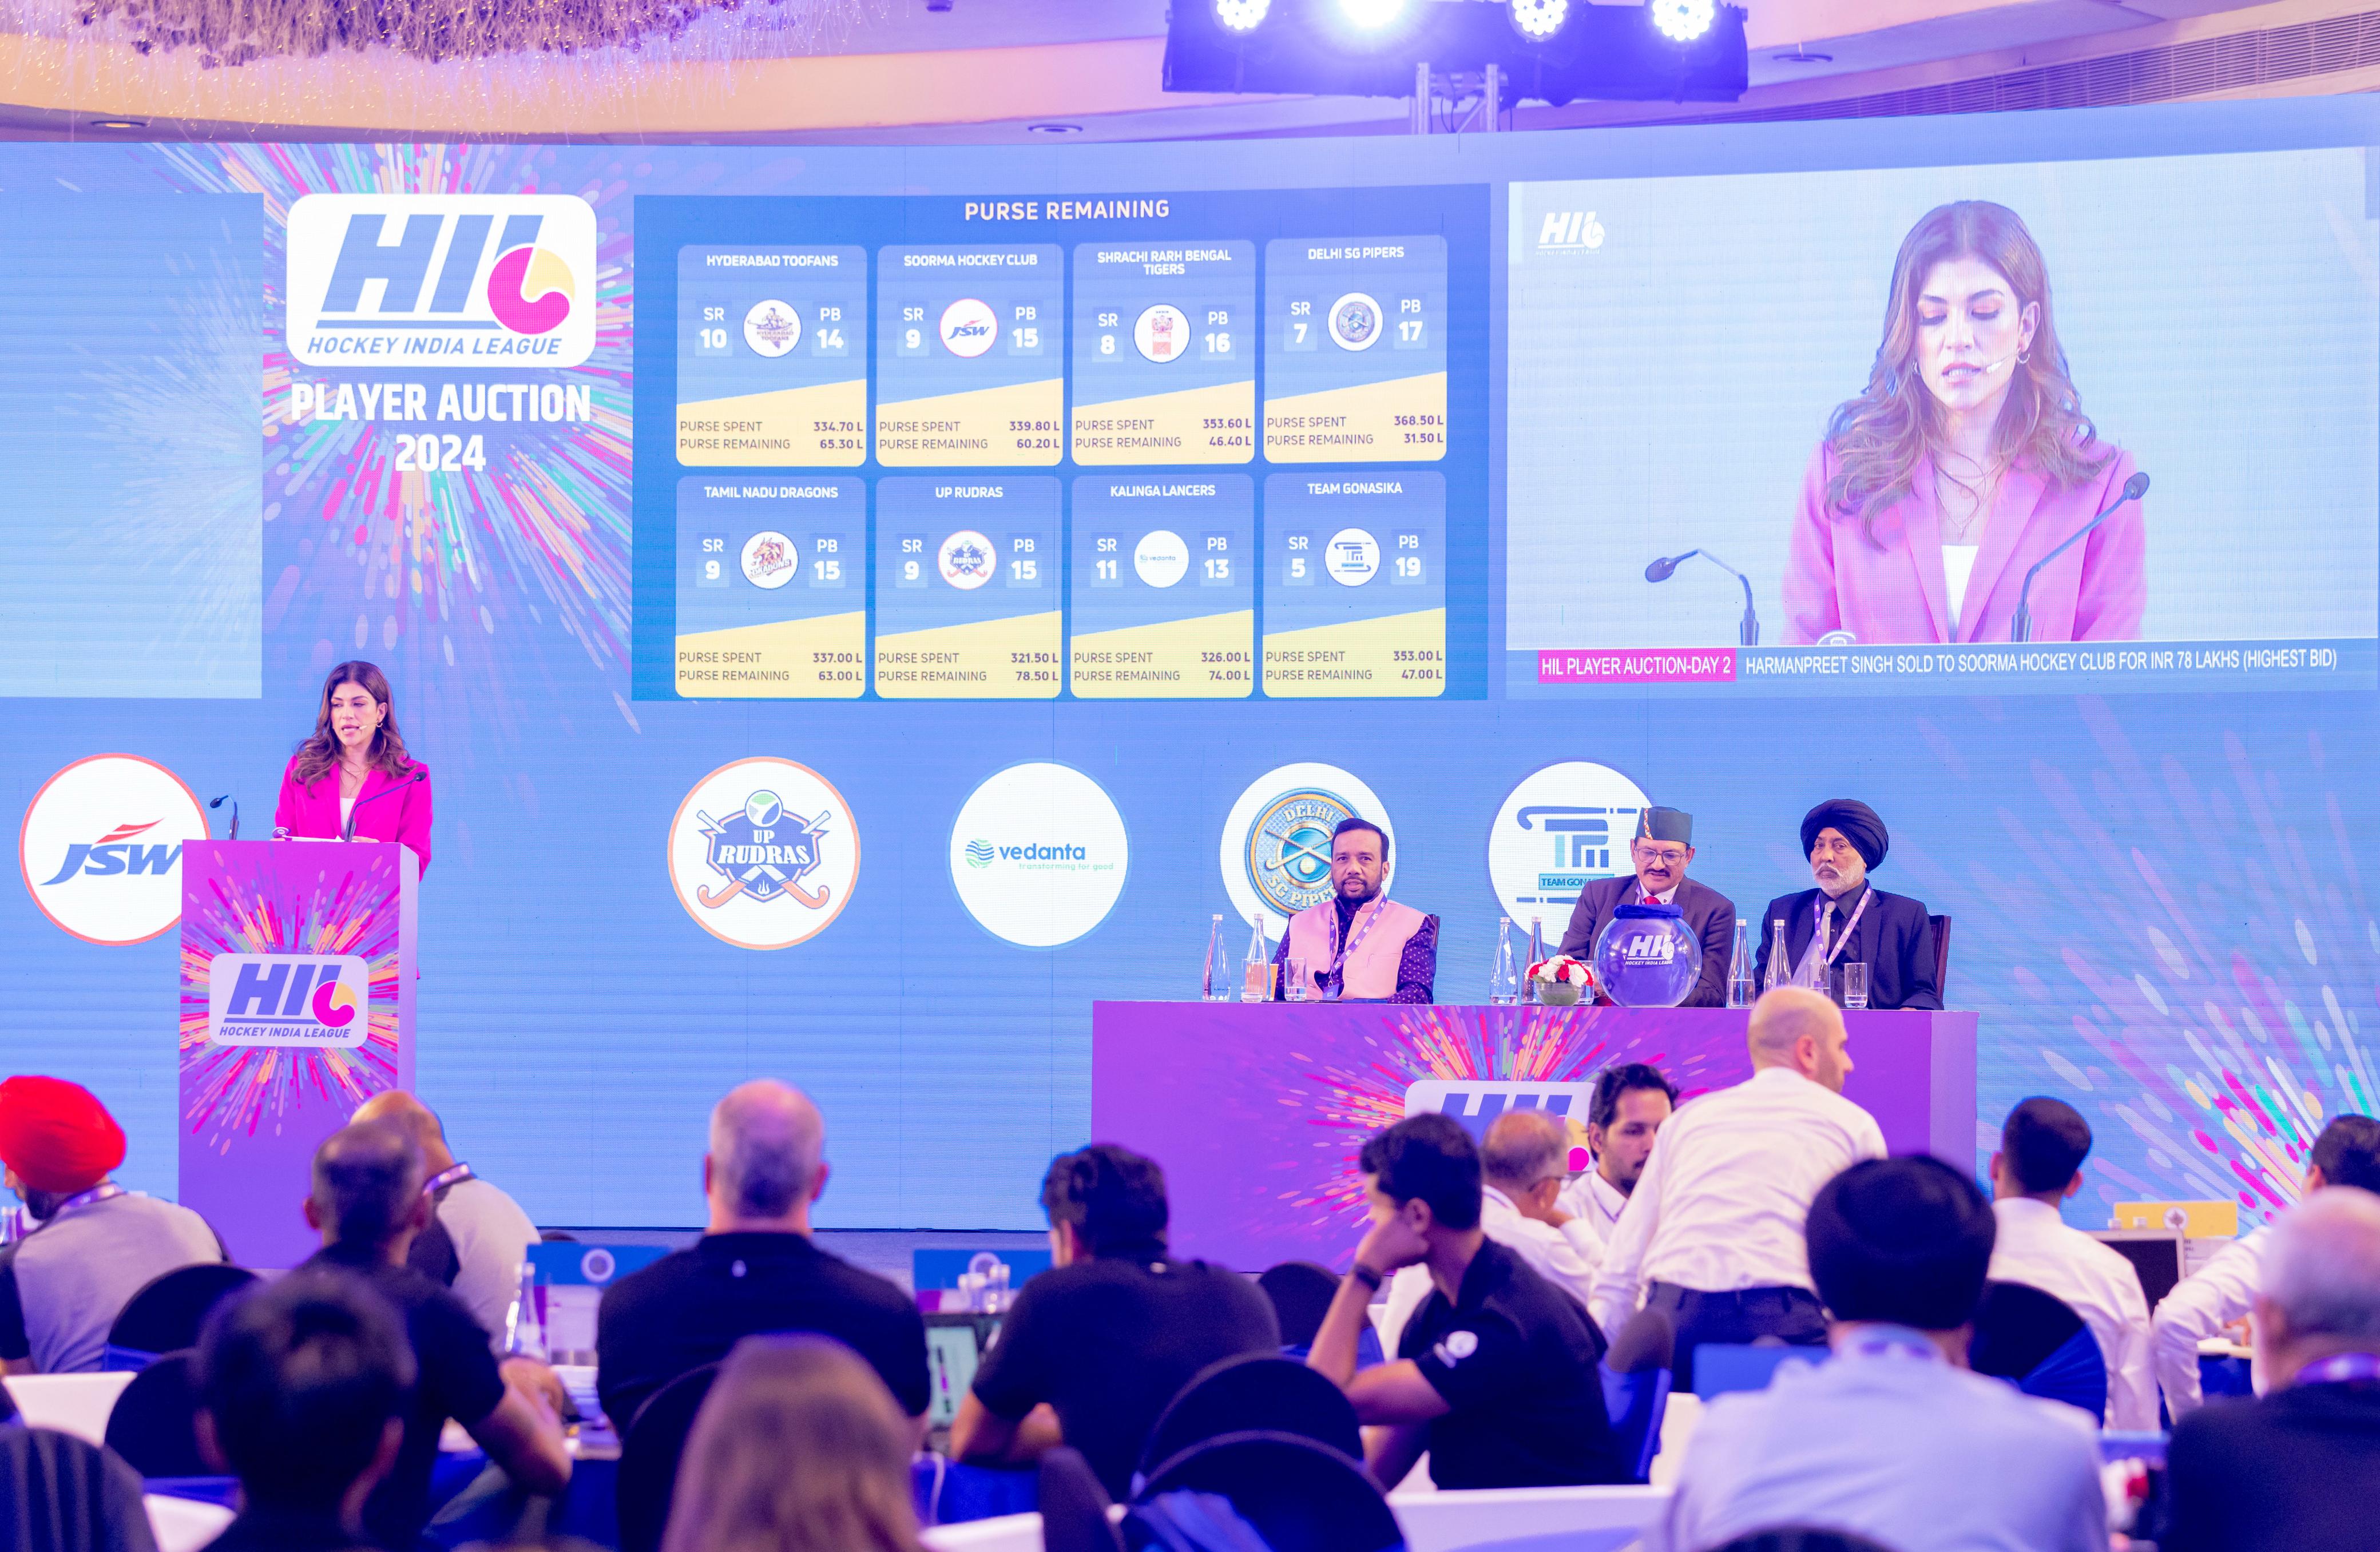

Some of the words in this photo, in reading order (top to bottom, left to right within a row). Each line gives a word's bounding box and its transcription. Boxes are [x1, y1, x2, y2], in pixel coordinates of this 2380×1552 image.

[965, 202, 1038, 220] PURSE
[1047, 200, 1169, 220] REMAINING
[1098, 251, 1148, 263] SHRACHI
[1151, 251, 1183, 261] RARH
[1185, 249, 1231, 261] BENGAL
[1308, 248, 1341, 259] DELHI
[1344, 248, 1360, 259] SG
[1363, 247, 1404, 259] PIPERS
[707, 255, 780, 266] HYDERABAD
[783, 255, 838, 266] TOOFANS
[905, 255, 955, 266] SOORMA
[958, 255, 1005, 265] HOCKEY
[1007, 255, 1037, 265] CLUB
[321, 214, 575, 334] HIL
[1144, 263, 1184, 275] TIGERS
[1291, 302, 1310, 315] SR
[1402, 300, 1421, 312] PB
[704, 308, 724, 320] SR
[820, 308, 840, 320] PB
[903, 308, 923, 320] SR
[1016, 307, 1036, 319] PB
[1209, 312, 1228, 325] PB
[1098, 313, 1117, 326] SR
[1294, 324, 1307, 344] 7
[1399, 321, 1423, 341] 17
[701, 330, 727, 348] 10
[817, 330, 844, 348] 14
[906, 330, 920, 348] 9
[1013, 328, 1038, 347] 15
[1205, 333, 1231, 352] 16
[308, 338, 398, 354] HOCKEY
[403, 338, 467, 354] INDIA
[473, 338, 562, 355] LEAGUE
[1101, 335, 1114, 355] 8
[291, 384, 426, 421] PLAYER
[437, 384, 590, 422] AUCTION
[680, 422, 719, 431] PURSE
[723, 421, 762, 431] SPENT
[814, 421, 854, 431] 334.70
[857, 422, 863, 431] L
[1009, 421, 1050, 431] 339.80
[1076, 420, 1114, 430] PURSE
[1117, 419, 1154, 430] SPENT
[1203, 419, 1242, 429] 353.60
[1267, 418, 1305, 428] PURSE
[1309, 417, 1346, 427] SPENT
[1394, 415, 1434, 426] 368.50
[880, 422, 918, 432] PURSE
[922, 422, 960, 431] SPENT
[680, 439, 719, 449] PURSE
[723, 438, 790, 449] REMAINING
[820, 439, 854, 449] 65.30
[857, 439, 863, 448] L
[880, 439, 918, 449] PURSE
[922, 439, 988, 449] REMAINING
[1017, 439, 1049, 448] 60.20
[1076, 438, 1113, 448] PURSE
[1117, 437, 1181, 447] REMAINING
[1209, 436, 1241, 446] 46.40
[1267, 435, 1305, 446] PURSE
[1309, 434, 1373, 444] REMAINING
[1405, 433, 1434, 443] 31.50
[395, 434, 486, 472] 2024
[705, 487, 740, 498] TAMIL
[743, 487, 777, 498] NADU
[780, 486, 838, 498] DRAGONS
[935, 487, 951, 497] UP
[954, 486, 1003, 498] RUDRAS
[1111, 486, 1160, 497] KALINGA
[1163, 485, 1215, 497] LANCERS
[1307, 483, 1340, 495] TEAM
[1343, 482, 1402, 494] GONASIKA
[703, 539, 723, 551] SR
[817, 539, 838, 552] PB
[902, 539, 922, 552] SR
[1014, 539, 1034, 552] PB
[1097, 539, 1117, 552] SR
[1207, 538, 1227, 551] PB
[1289, 537, 1308, 550] SR
[1399, 535, 1418, 549] PB
[705, 561, 720, 579] 9
[814, 561, 840, 579] 15
[905, 561, 919, 580] 9
[1011, 561, 1037, 579] 15
[1096, 561, 1117, 579] 11
[1205, 559, 1229, 578] 13
[1291, 559, 1305, 578] 5
[1396, 557, 1421, 576] 19
[680, 653, 719, 662] PURSE
[723, 652, 761, 662] SPENT
[813, 653, 852, 663] 337.00
[879, 653, 918, 664] PURSE
[921, 653, 959, 663] SPENT
[1011, 653, 1049, 663] 321.50
[1074, 653, 1112, 663] PURSE
[1116, 652, 1153, 662] SPENT
[1201, 652, 1241, 662] 326.00
[1266, 652, 1303, 662] PURSE
[1307, 651, 1344, 661] SPENT
[1394, 651, 1434, 661] 353.00
[1747, 657, 1849, 674] HARMANPREET
[1851, 656, 1893, 672] SINGH
[1897, 656, 1933, 672] SOLD
[1937, 655, 1955, 671] TO
[1958, 654, 2017, 671] SOORMA
[2021, 653, 2076, 670] HOCKEY
[2080, 653, 2116, 669] CLUB
[2119, 653, 2147, 669] FOR
[2151, 652, 2173, 669] INR
[2177, 652, 2192, 668] 78
[2196, 651, 2239, 668] LAKHS
[2243, 650, 2307, 671] (HIGHEST
[2310, 649, 2337, 670] BID)
[1542, 660, 1563, 675] HIL
[1567, 658, 1621, 675] PLAYER
[1624, 657, 1719, 674] AUCTION-DAY
[1723, 657, 1731, 673] 2
[680, 670, 719, 681] PURSE
[723, 670, 789, 681] REMAINING
[819, 671, 852, 681] 63.00
[879, 671, 918, 681] PURSE
[921, 671, 986, 681] REMAINING
[1016, 671, 1049, 681] 78.50
[1074, 671, 1112, 681] PURSE
[1116, 670, 1180, 681] REMAINING
[1209, 670, 1241, 681] 74.00
[1266, 670, 1304, 680] PURSE
[1307, 669, 1372, 680] REMAINING
[1402, 669, 1434, 680] 47.00
[1284, 805, 1334, 822] DELHI
[753, 830, 775, 843] UP
[717, 846, 810, 864] RUDRAS
[999, 843, 1085, 860] vedanta
[39, 843, 182, 886] JSW
[1093, 863, 1113, 871] good
[226, 963, 358, 1027] HIL
[220, 1027, 267, 1037] HOCKEY
[269, 1027, 300, 1037] INDIA
[304, 1028, 351, 1038] LEAGUE
